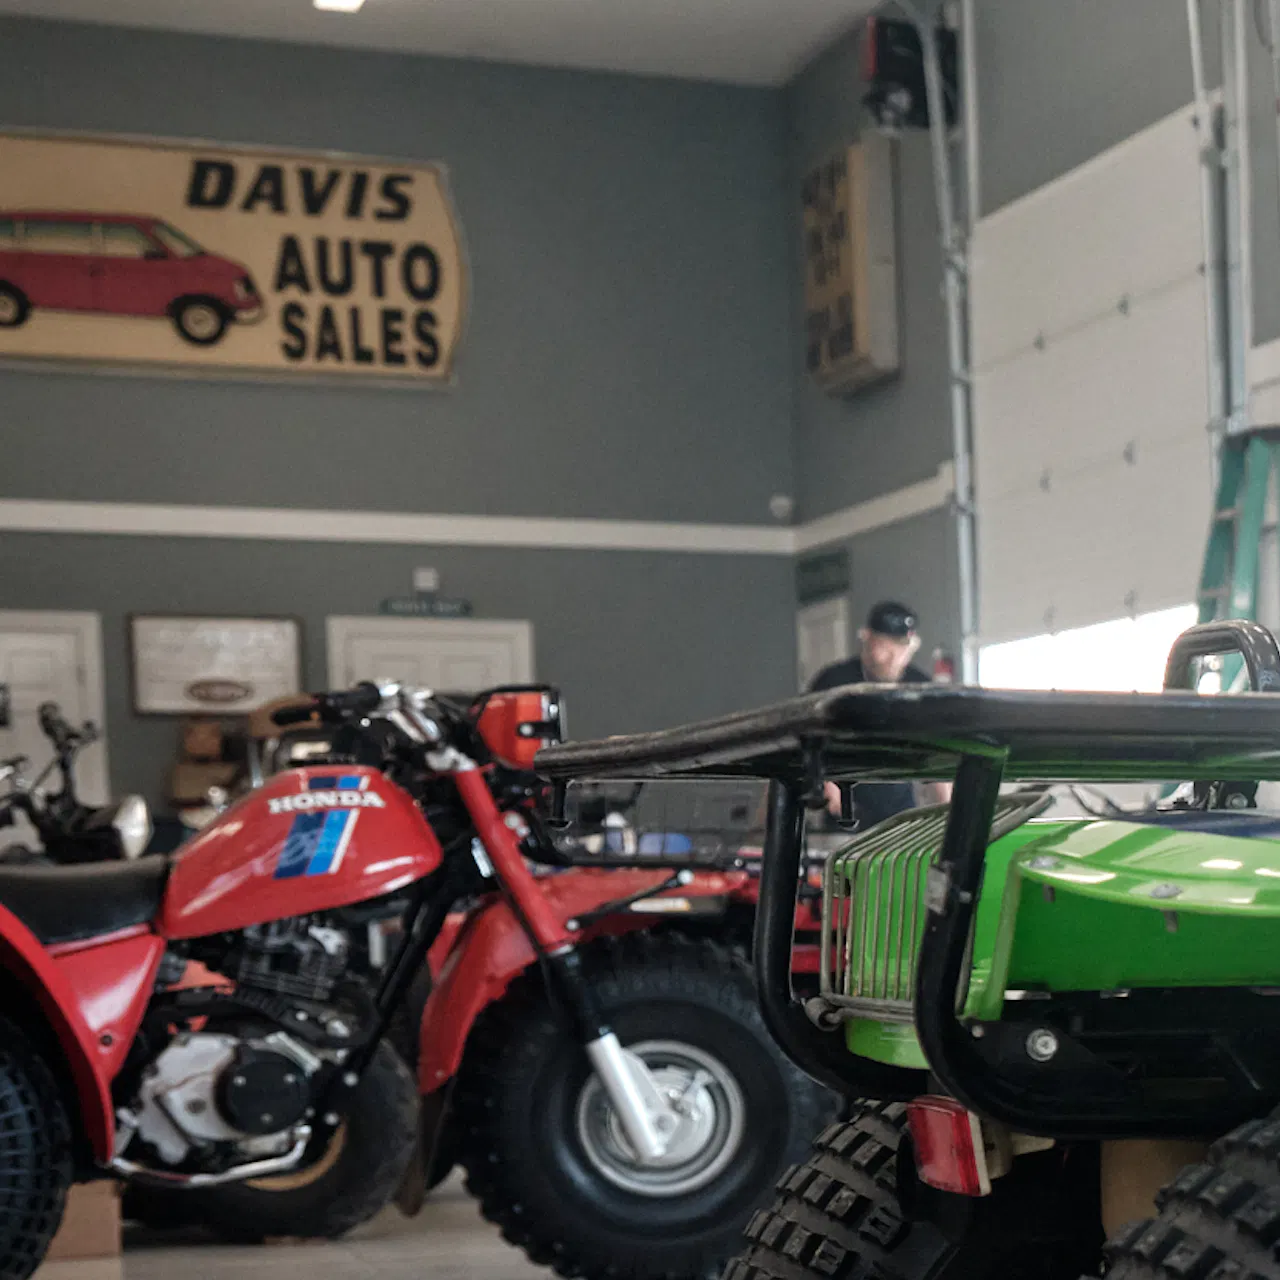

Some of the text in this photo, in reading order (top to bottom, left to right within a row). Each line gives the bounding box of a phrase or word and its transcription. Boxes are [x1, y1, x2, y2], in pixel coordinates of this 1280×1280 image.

[185, 159, 414, 222] DAVIS
[274, 233, 442, 301] AUTO
[280, 302, 441, 368] SALES
[268, 790, 386, 814] HONDA
